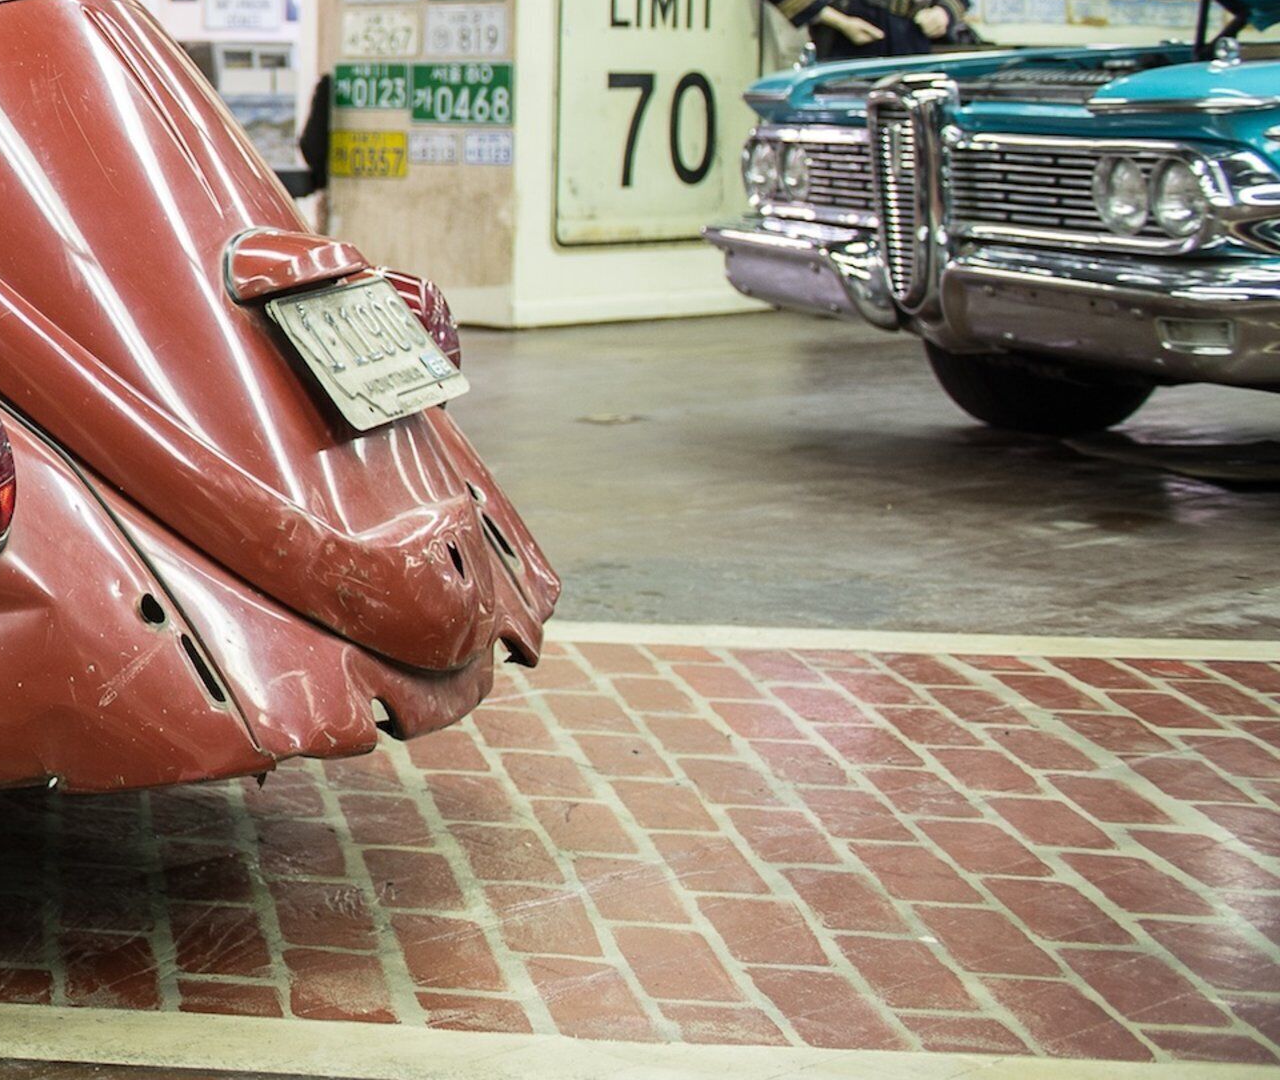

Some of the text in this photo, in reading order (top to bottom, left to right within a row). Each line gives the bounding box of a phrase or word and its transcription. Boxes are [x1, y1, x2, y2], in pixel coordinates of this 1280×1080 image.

[351, 77, 407, 108] 0123
[434, 86, 511, 122] 0468
[606, 72, 718, 189] 70
[351, 146, 404, 177] 0357
